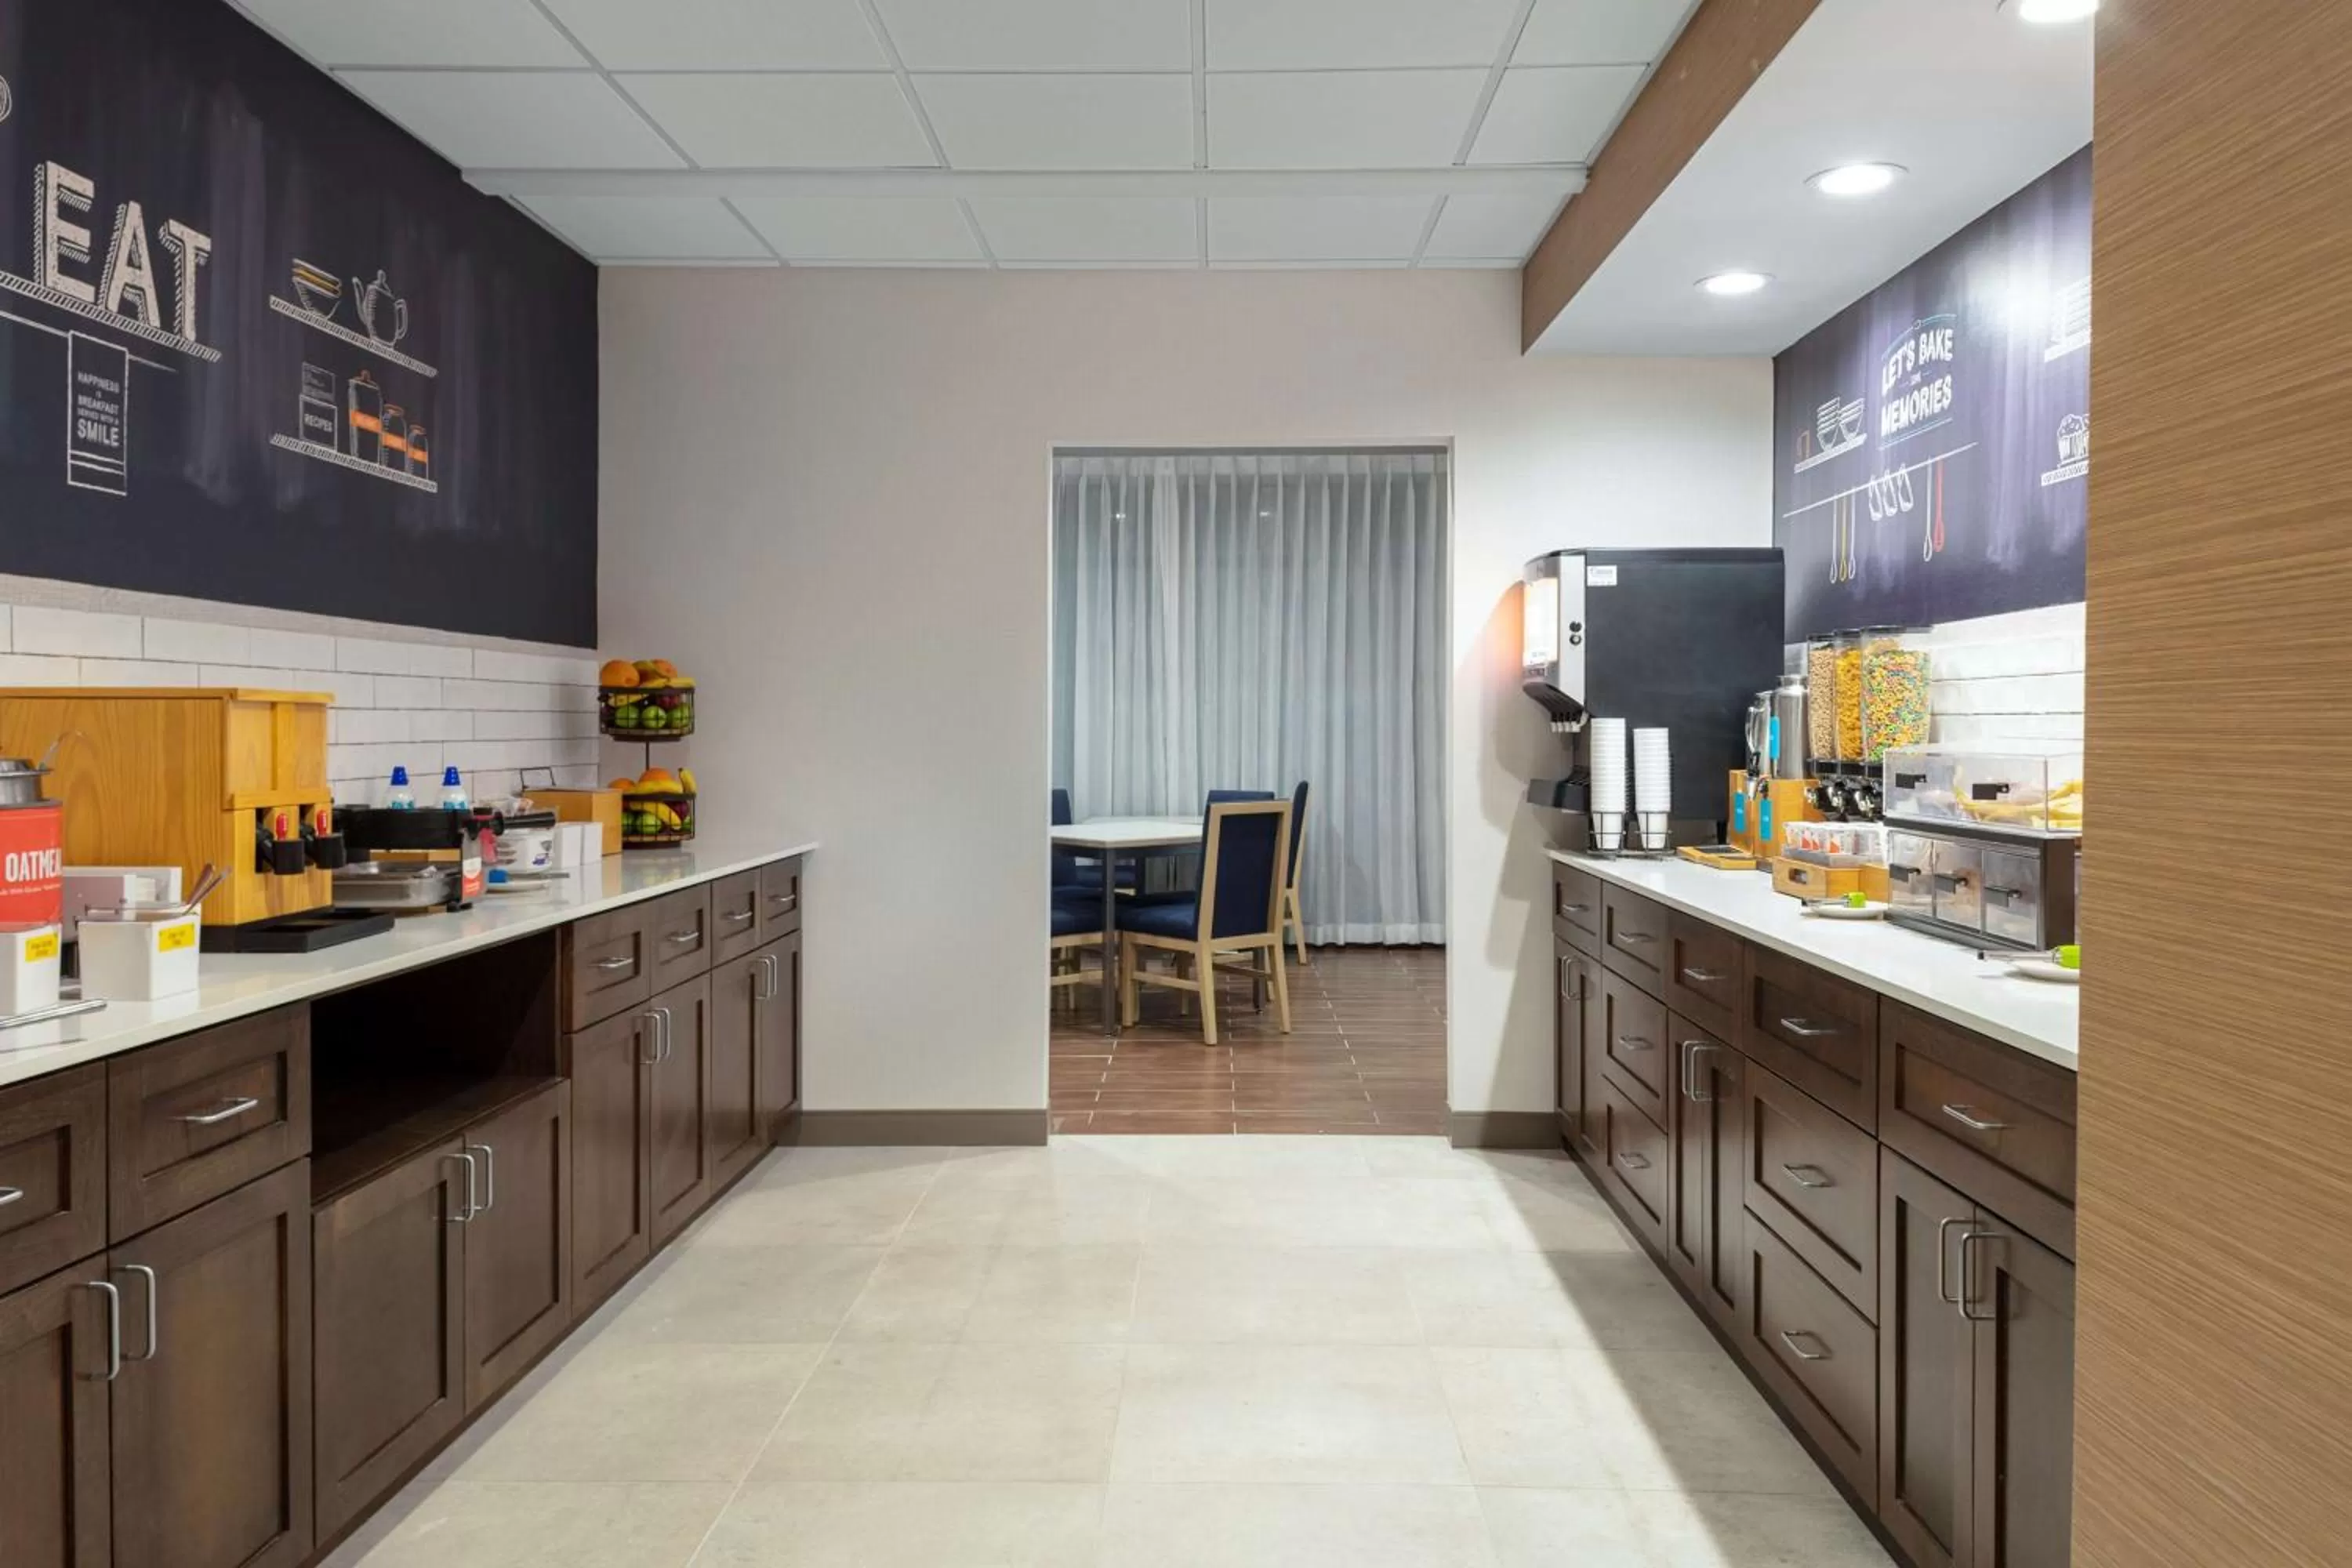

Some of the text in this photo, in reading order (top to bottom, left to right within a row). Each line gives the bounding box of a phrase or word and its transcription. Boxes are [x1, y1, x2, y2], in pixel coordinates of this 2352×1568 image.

[34, 160, 212, 342] EAT
[1882, 328, 1954, 398] LET'S BAKE
[78, 394, 119, 416] BREAKFAST
[1882, 375, 1952, 437] MEMORIES
[77, 418, 120, 446] SMILE
[5, 848, 62, 883] OATMEA
